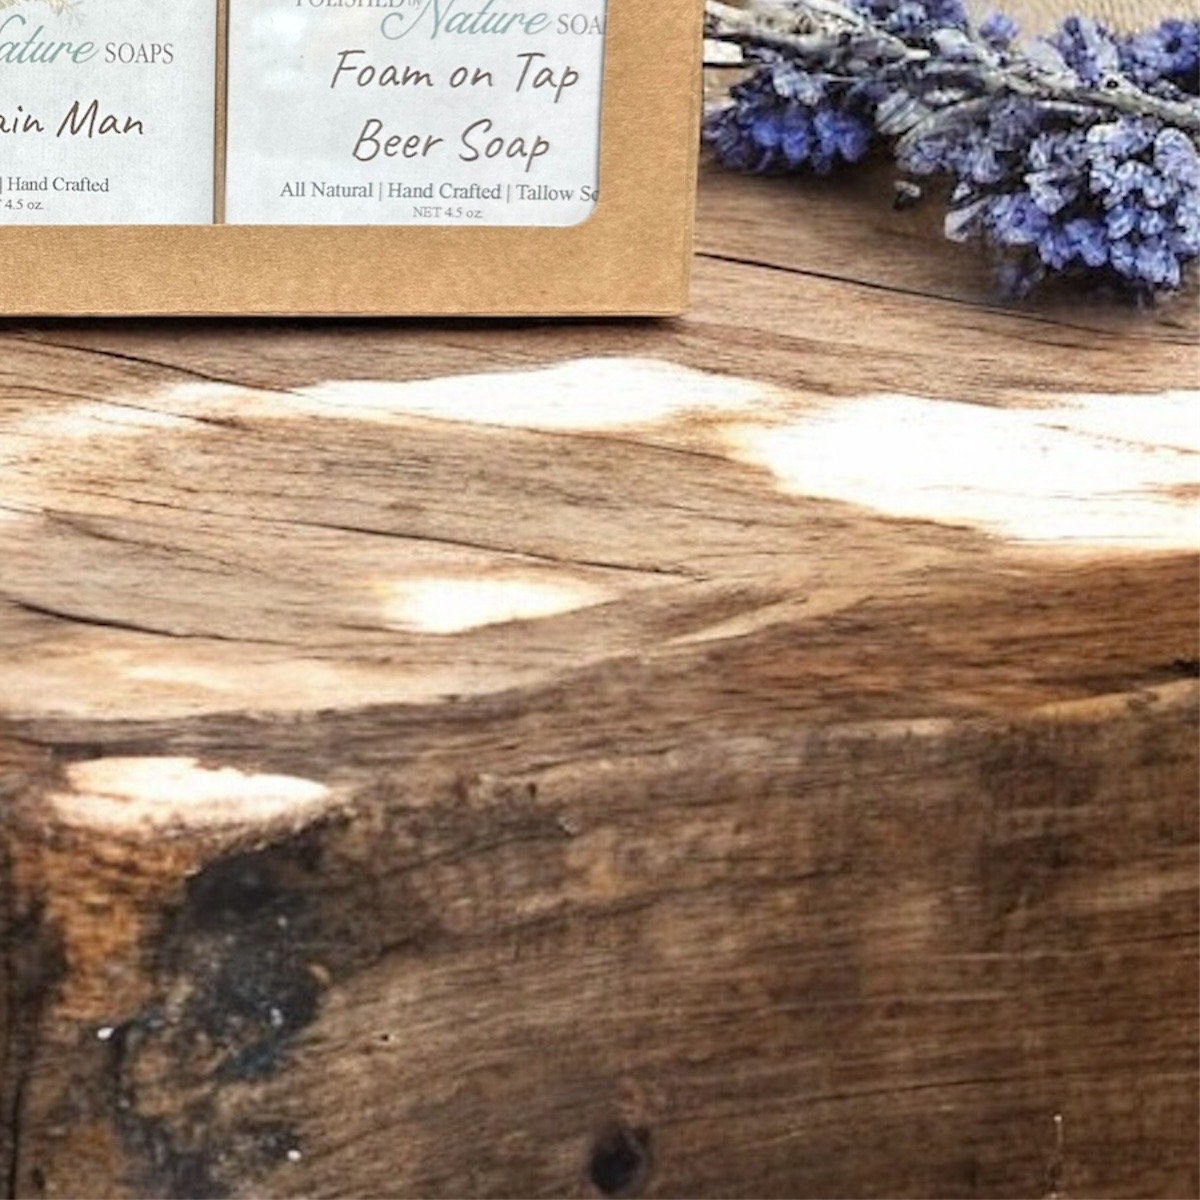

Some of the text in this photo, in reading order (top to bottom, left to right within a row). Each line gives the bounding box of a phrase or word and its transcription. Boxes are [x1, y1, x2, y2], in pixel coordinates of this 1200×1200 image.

[103, 41, 175, 65] SOAPS
[330, 48, 580, 104] Foam on Tap
[56, 99, 145, 139] Man
[351, 117, 551, 173] Beer Soap
[7, 176, 48, 192] Hand
[52, 176, 110, 193] Crafted
[280, 181, 306, 198] All
[310, 181, 374, 198] Natural
[387, 182, 434, 199] Hand
[438, 182, 502, 200] Crafted
[515, 184, 574, 201] Tallow
[4, 198, 24, 211] 4.5
[412, 205, 442, 219] NET
[444, 205, 463, 219] 4.5
